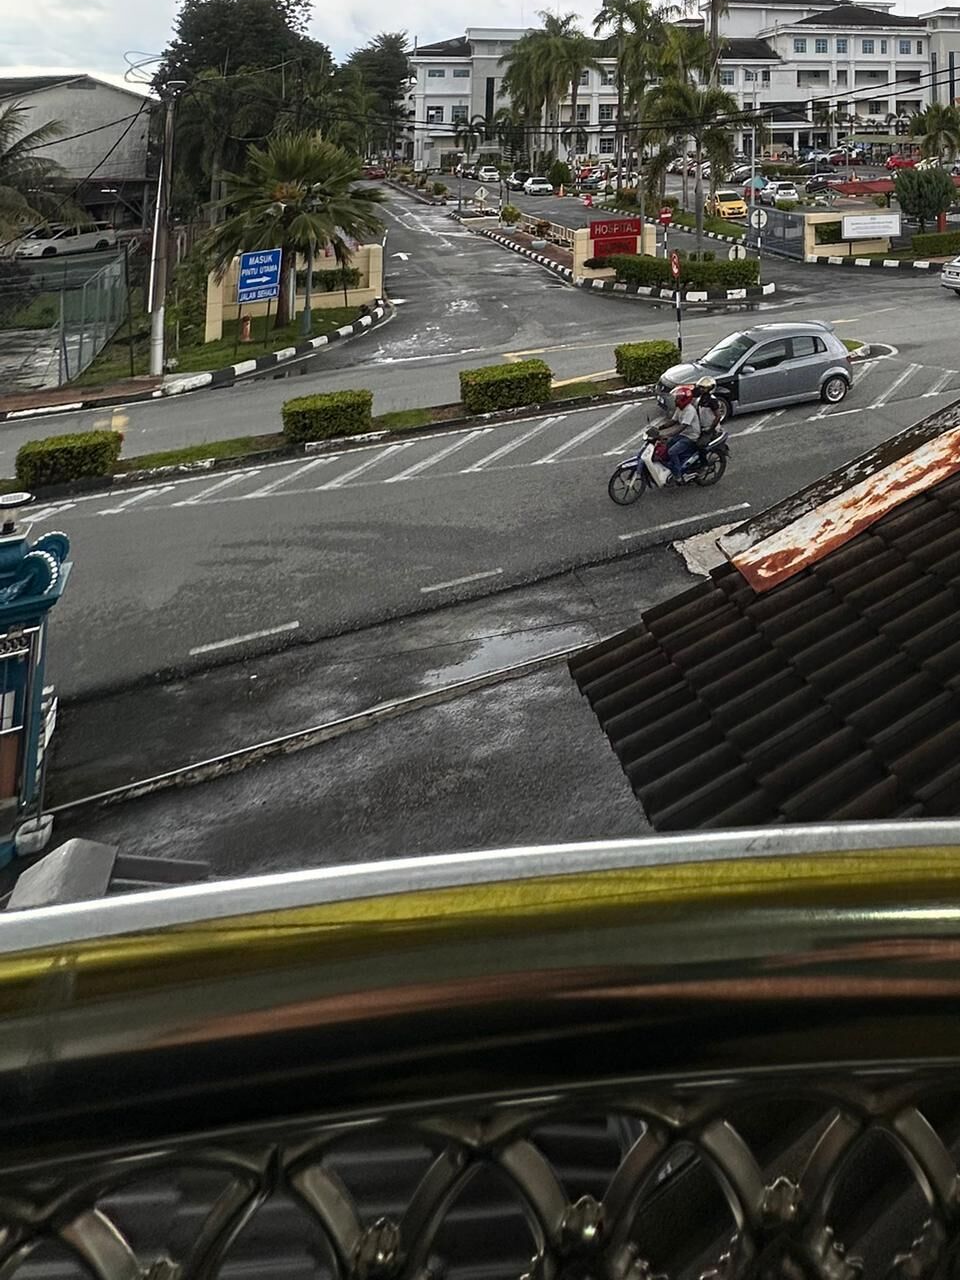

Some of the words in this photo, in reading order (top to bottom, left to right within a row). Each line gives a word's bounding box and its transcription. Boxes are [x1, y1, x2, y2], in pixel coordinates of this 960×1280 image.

[249, 255, 273, 265] MASUK
[241, 268, 258, 277] PINTU
[260, 264, 277, 273] UTAMA
[240, 292, 256, 301] JALAN
[257, 288, 277, 298] SEHALA
